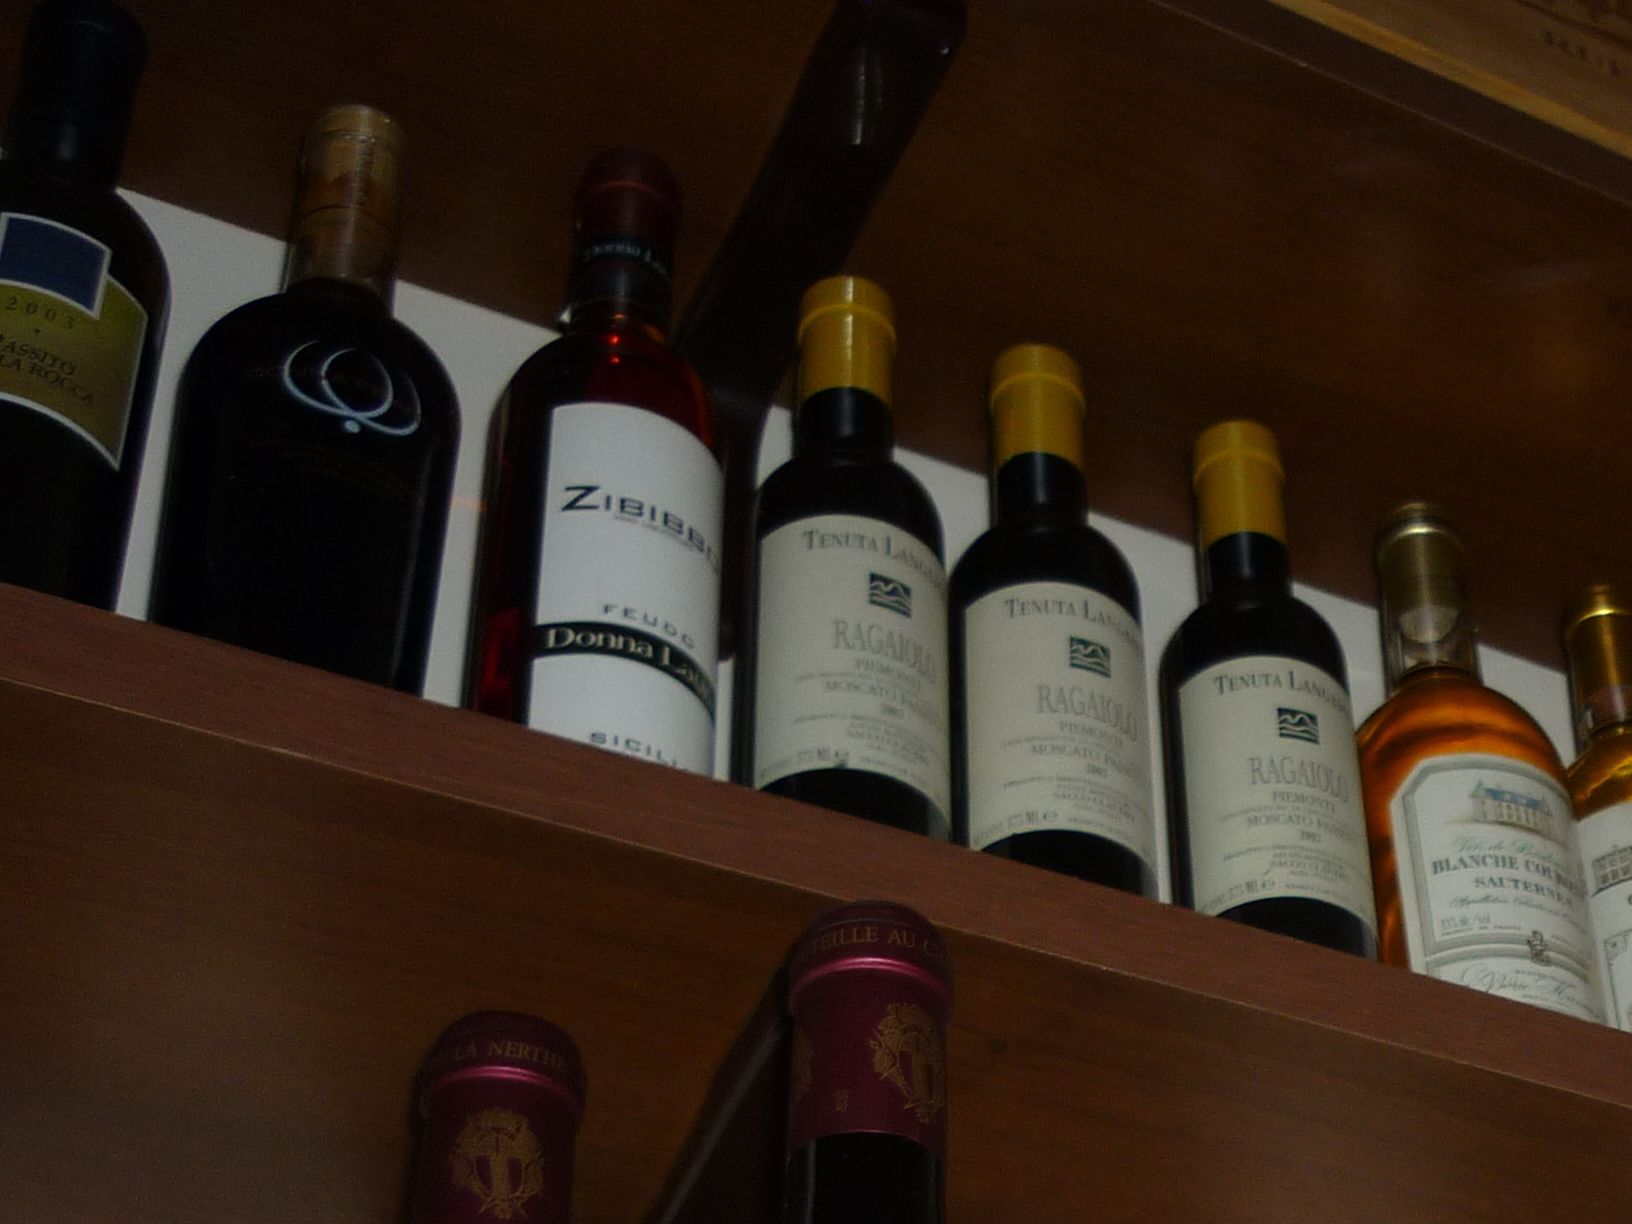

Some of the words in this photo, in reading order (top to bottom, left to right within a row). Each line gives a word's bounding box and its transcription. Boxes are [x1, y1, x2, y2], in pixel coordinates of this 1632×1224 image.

[545, 627, 654, 659] Donna
[1213, 673, 1283, 696] TENUTA
[1432, 854, 1520, 876] BLANCHE
